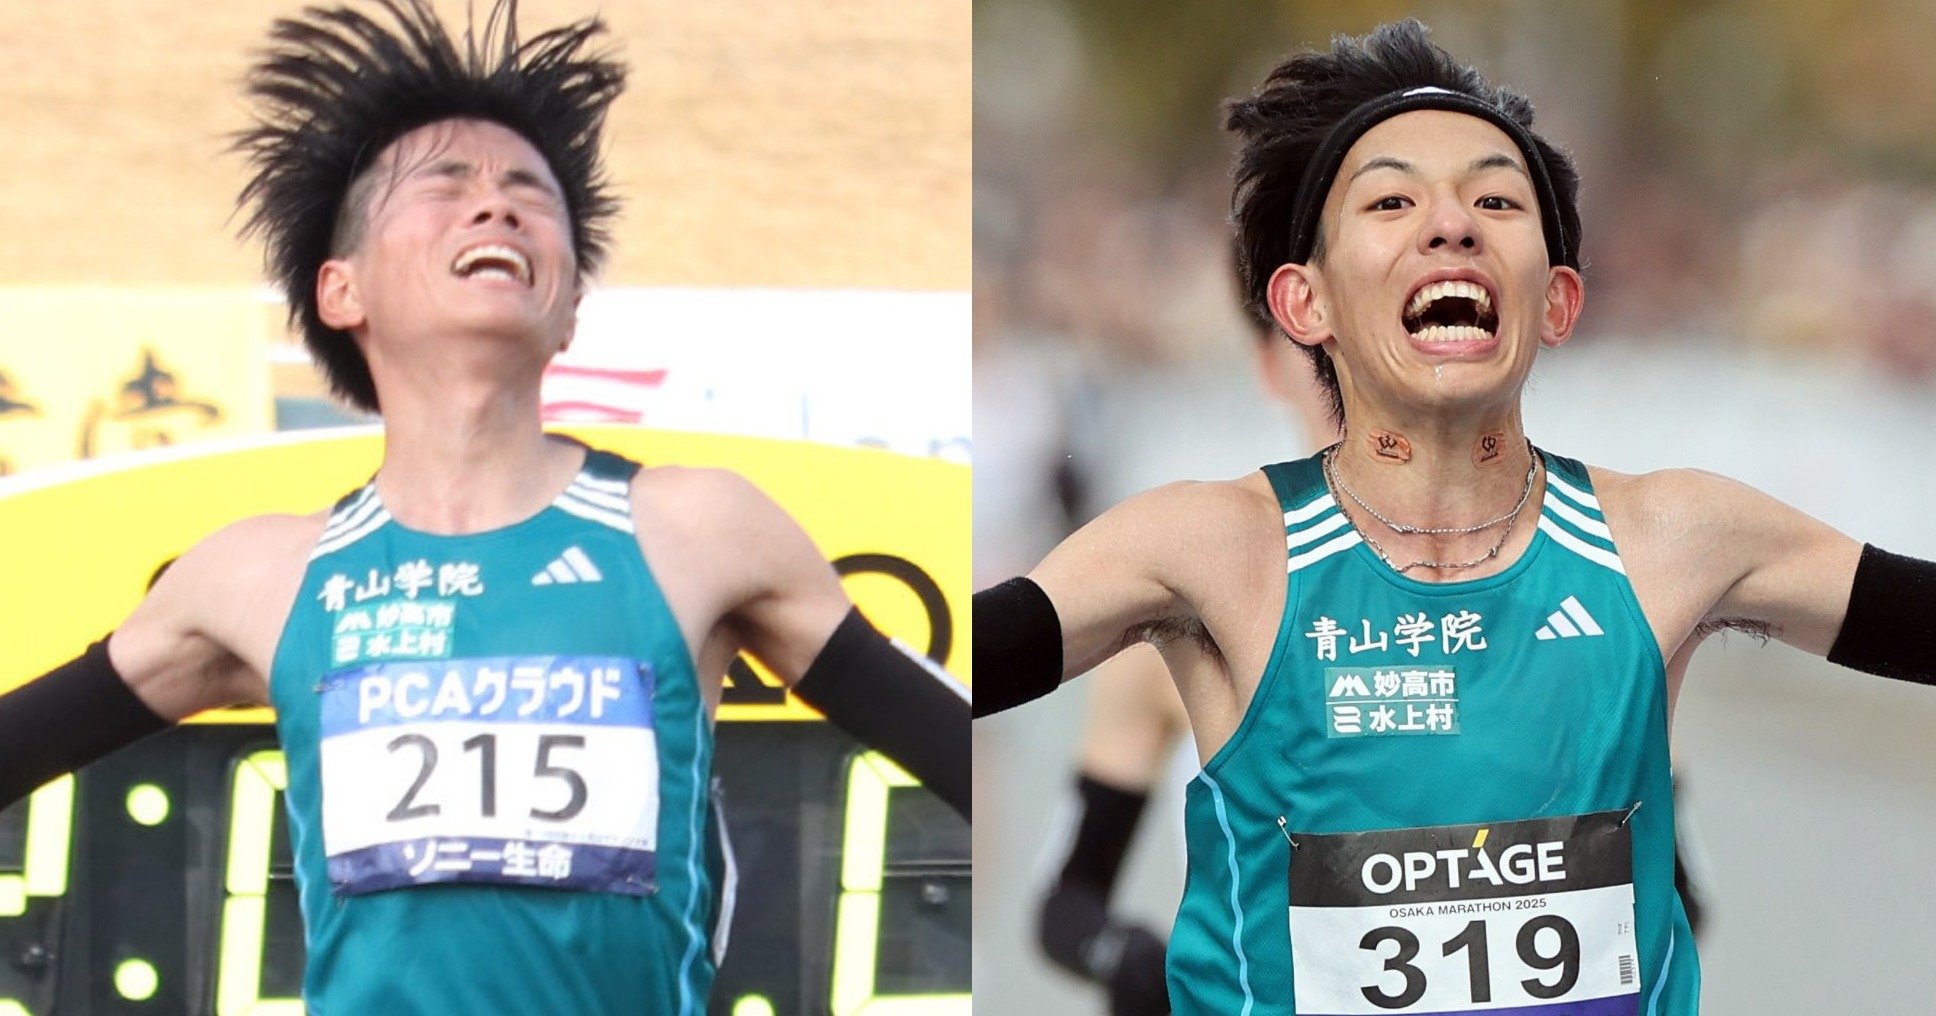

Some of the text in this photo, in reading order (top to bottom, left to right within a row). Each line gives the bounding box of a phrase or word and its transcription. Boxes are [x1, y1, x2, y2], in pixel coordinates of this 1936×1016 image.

[317, 559, 484, 612] 青山学院
[365, 628, 447, 657] 水上村
[1305, 610, 1487, 661] 青山学院
[360, 668, 620, 723] PCAクラウド
[1373, 670, 1456, 698] 妙高市
[1369, 703, 1454, 731] 水上村
[386, 732, 588, 823] 215
[403, 840, 574, 880] ソニー生命
[1360, 829, 1567, 895] OPTAGE
[1389, 898, 1546, 918] OSAKA MARATHON 2025
[1358, 914, 1580, 1010] 319
